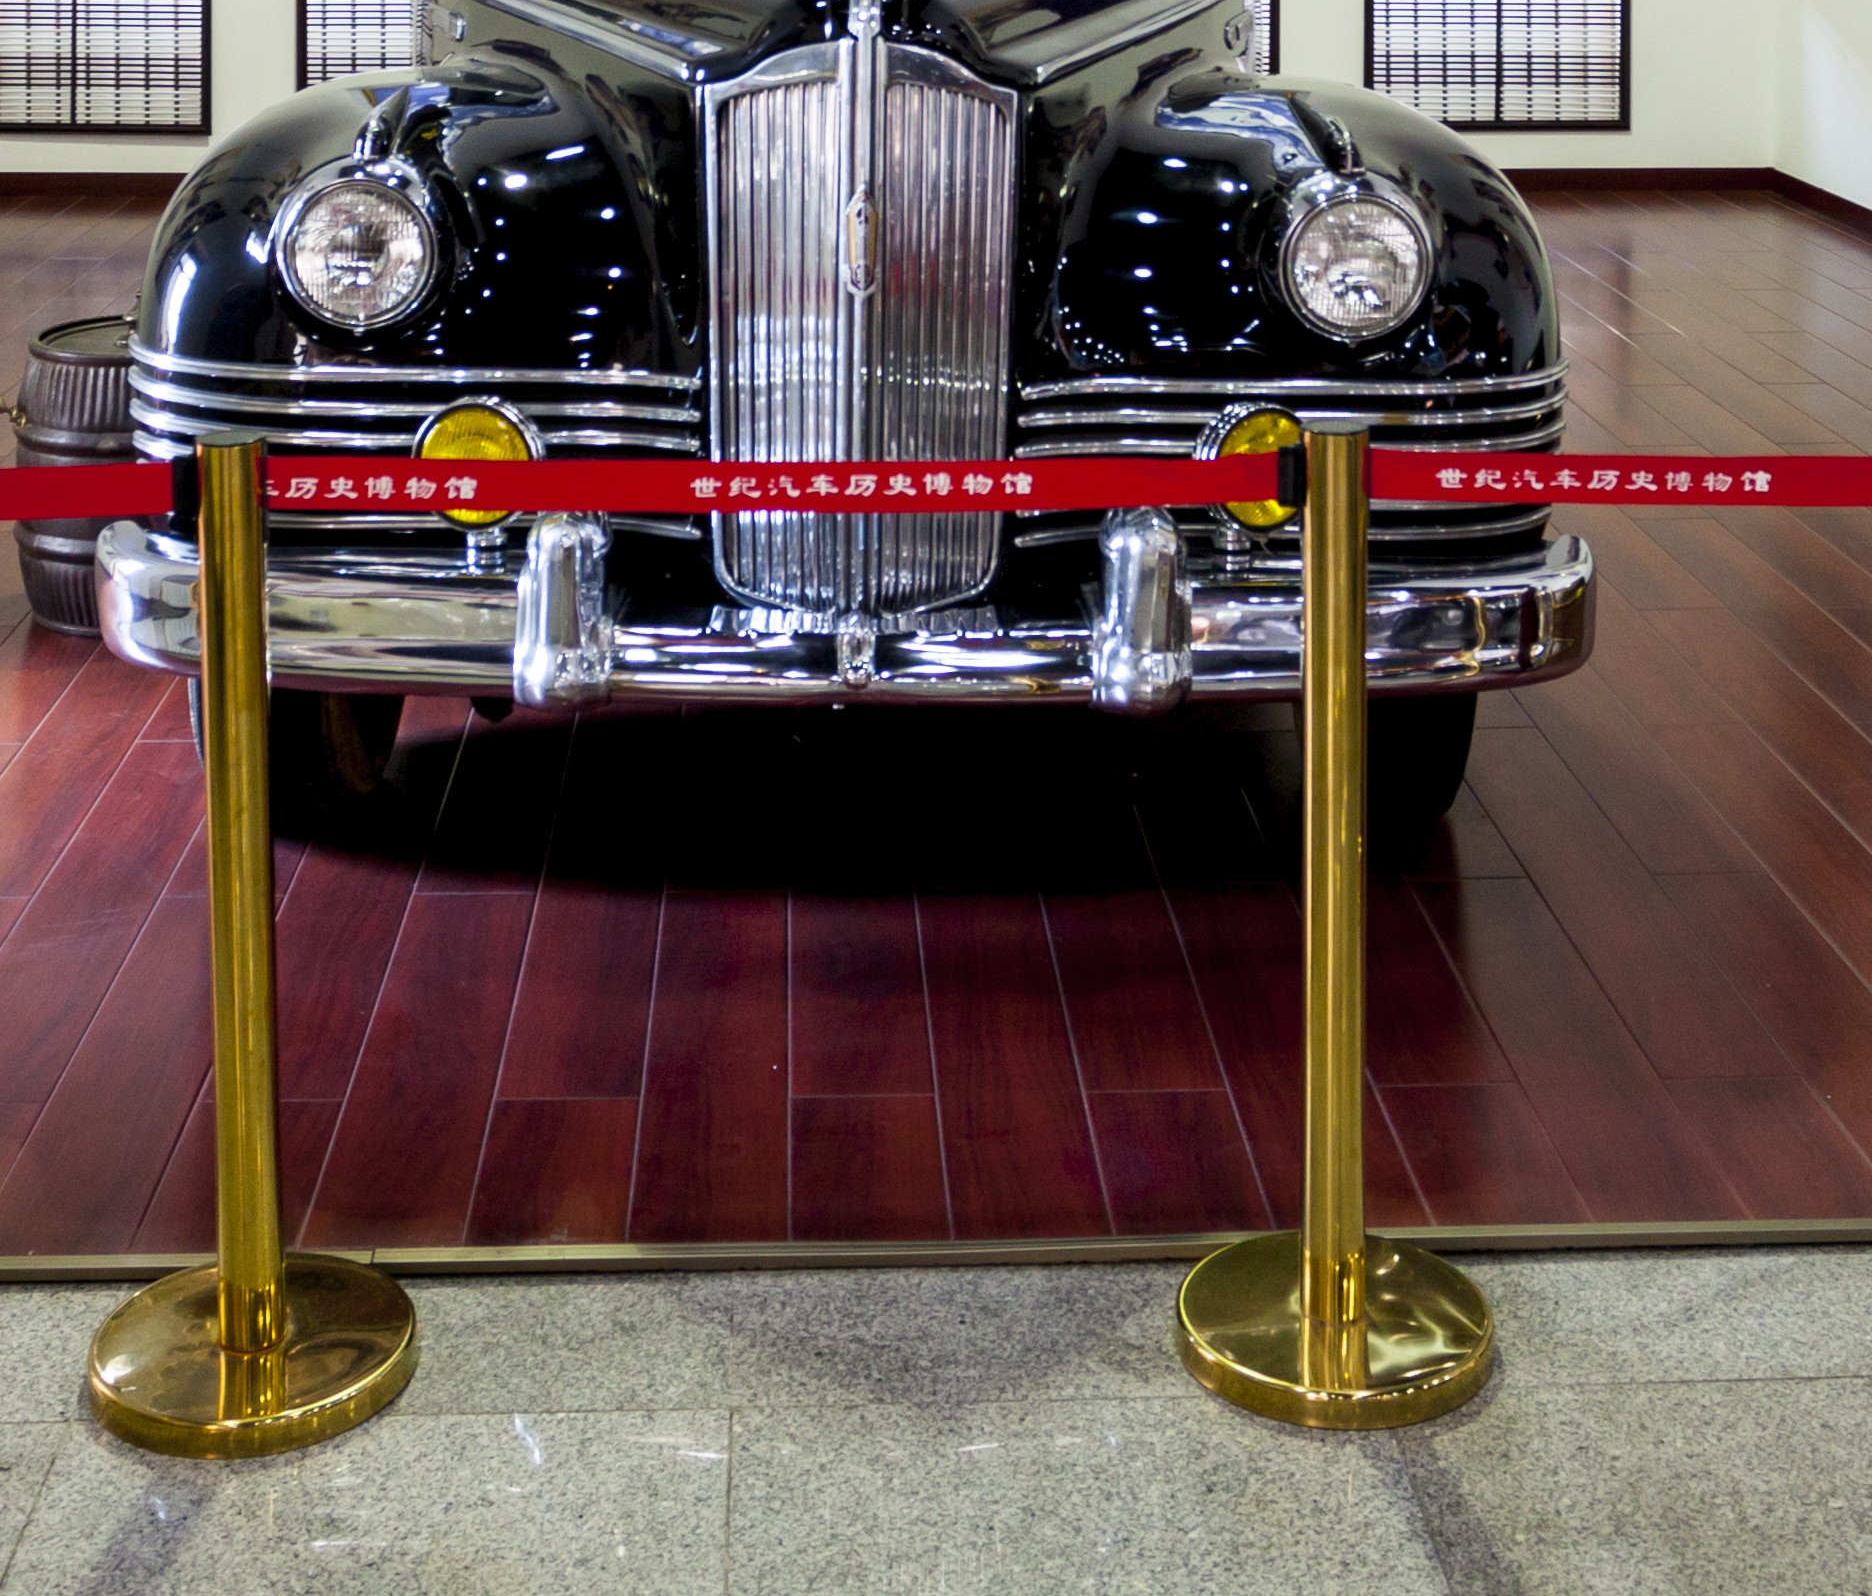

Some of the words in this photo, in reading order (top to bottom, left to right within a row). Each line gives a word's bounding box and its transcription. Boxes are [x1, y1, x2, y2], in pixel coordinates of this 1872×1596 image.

[689, 472, 1033, 499] 世纪汽车历史博物馆
[1435, 468, 1772, 493] 世纪汽车历史博物馆
